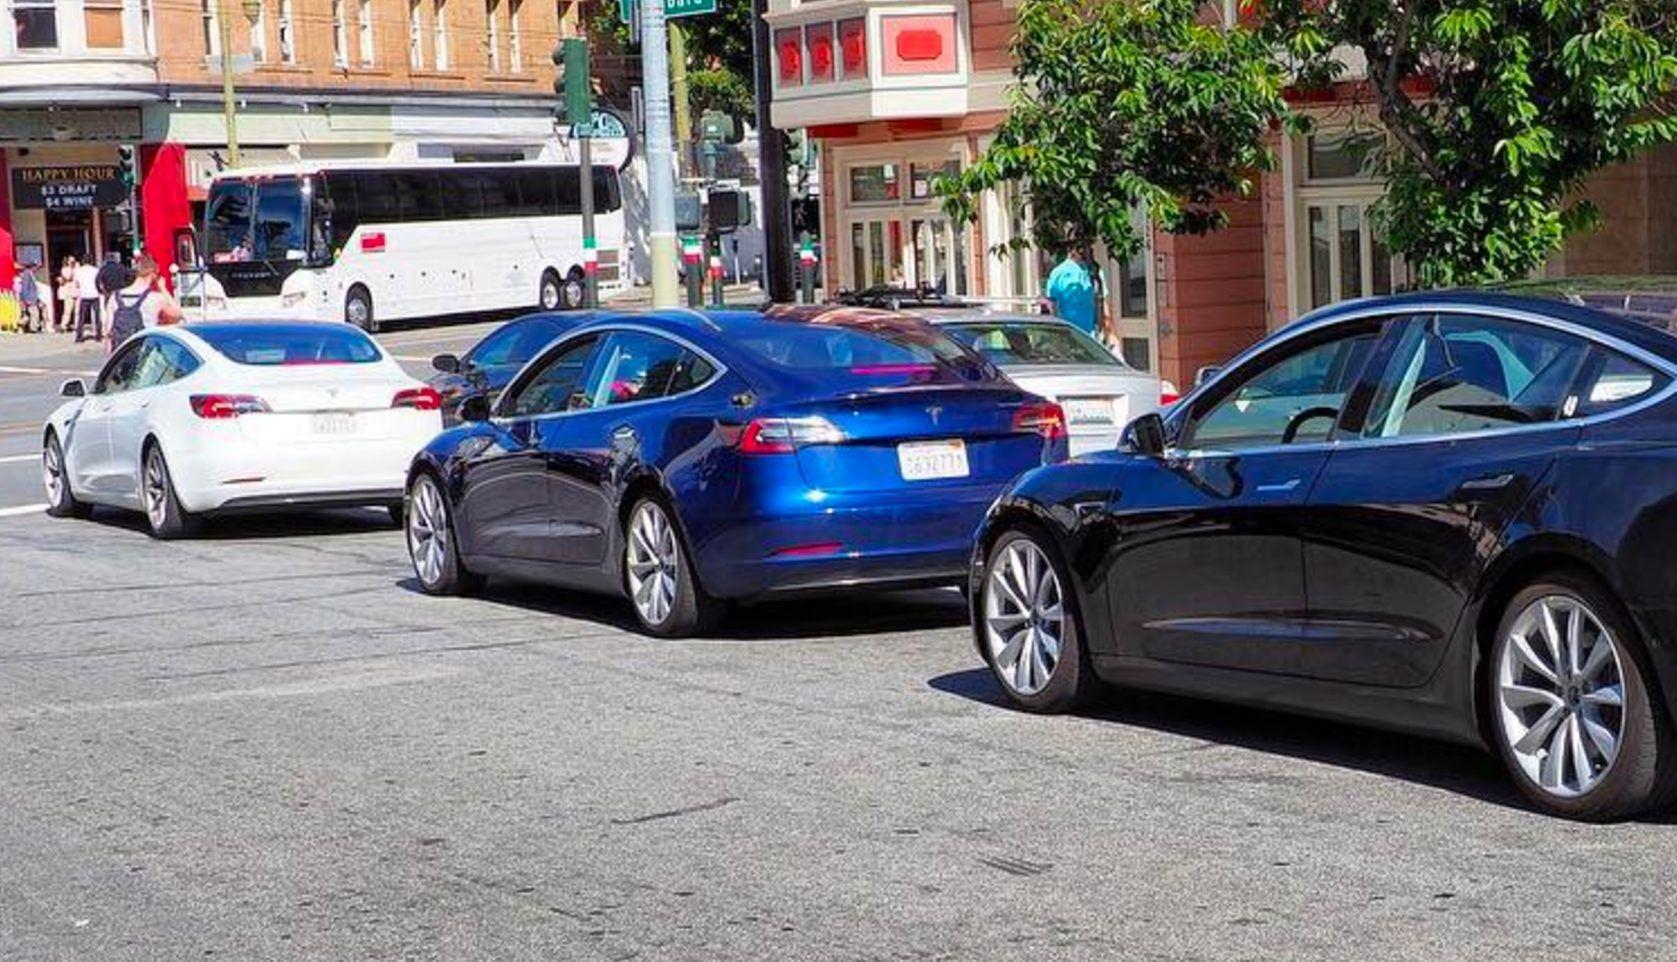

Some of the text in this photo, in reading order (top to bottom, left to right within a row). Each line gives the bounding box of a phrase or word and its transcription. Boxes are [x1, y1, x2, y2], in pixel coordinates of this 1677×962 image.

[22, 168, 115, 180] HAPPY HOUR
[59, 184, 97, 195] DRAFT
[63, 196, 94, 206] WINE
